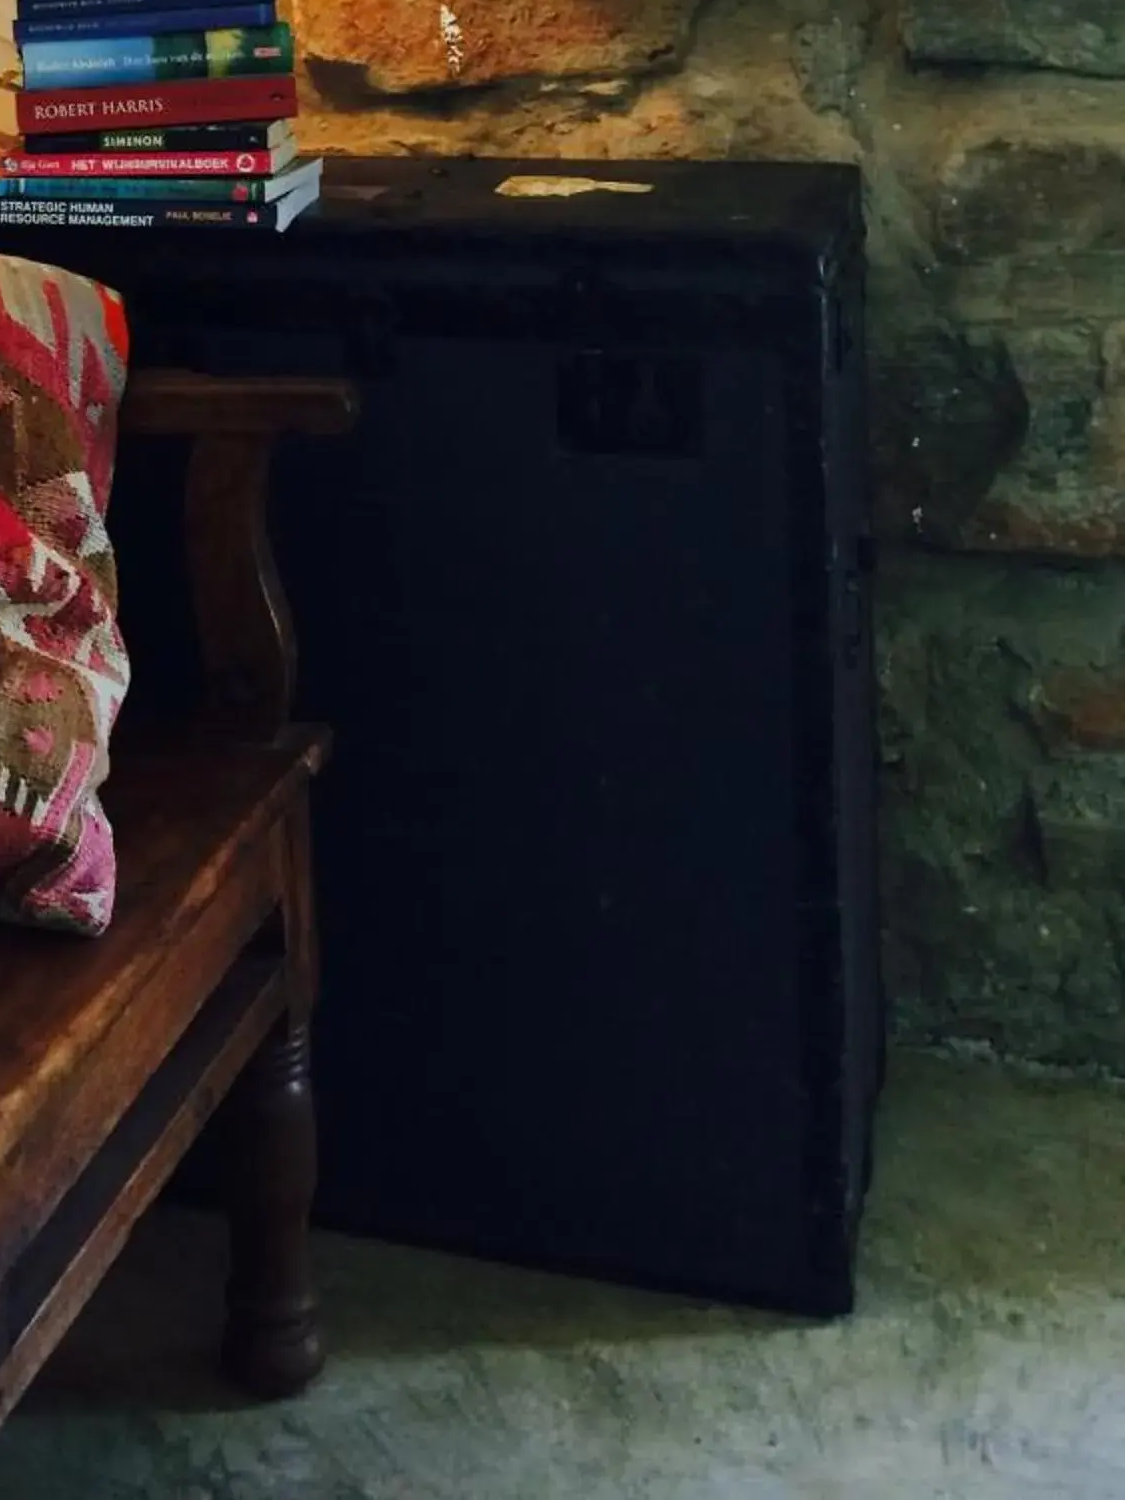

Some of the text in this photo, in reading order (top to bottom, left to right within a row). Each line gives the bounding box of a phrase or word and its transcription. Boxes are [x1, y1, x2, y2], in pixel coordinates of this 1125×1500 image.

[34, 98, 164, 120] ROBERT HARRIS
[103, 135, 163, 148] SIMENON
[71, 159, 95, 171] HET
[0, 201, 114, 213] STRATEGIC HUMAN
[0, 213, 155, 227] RESOURCE MANAGEMENT
